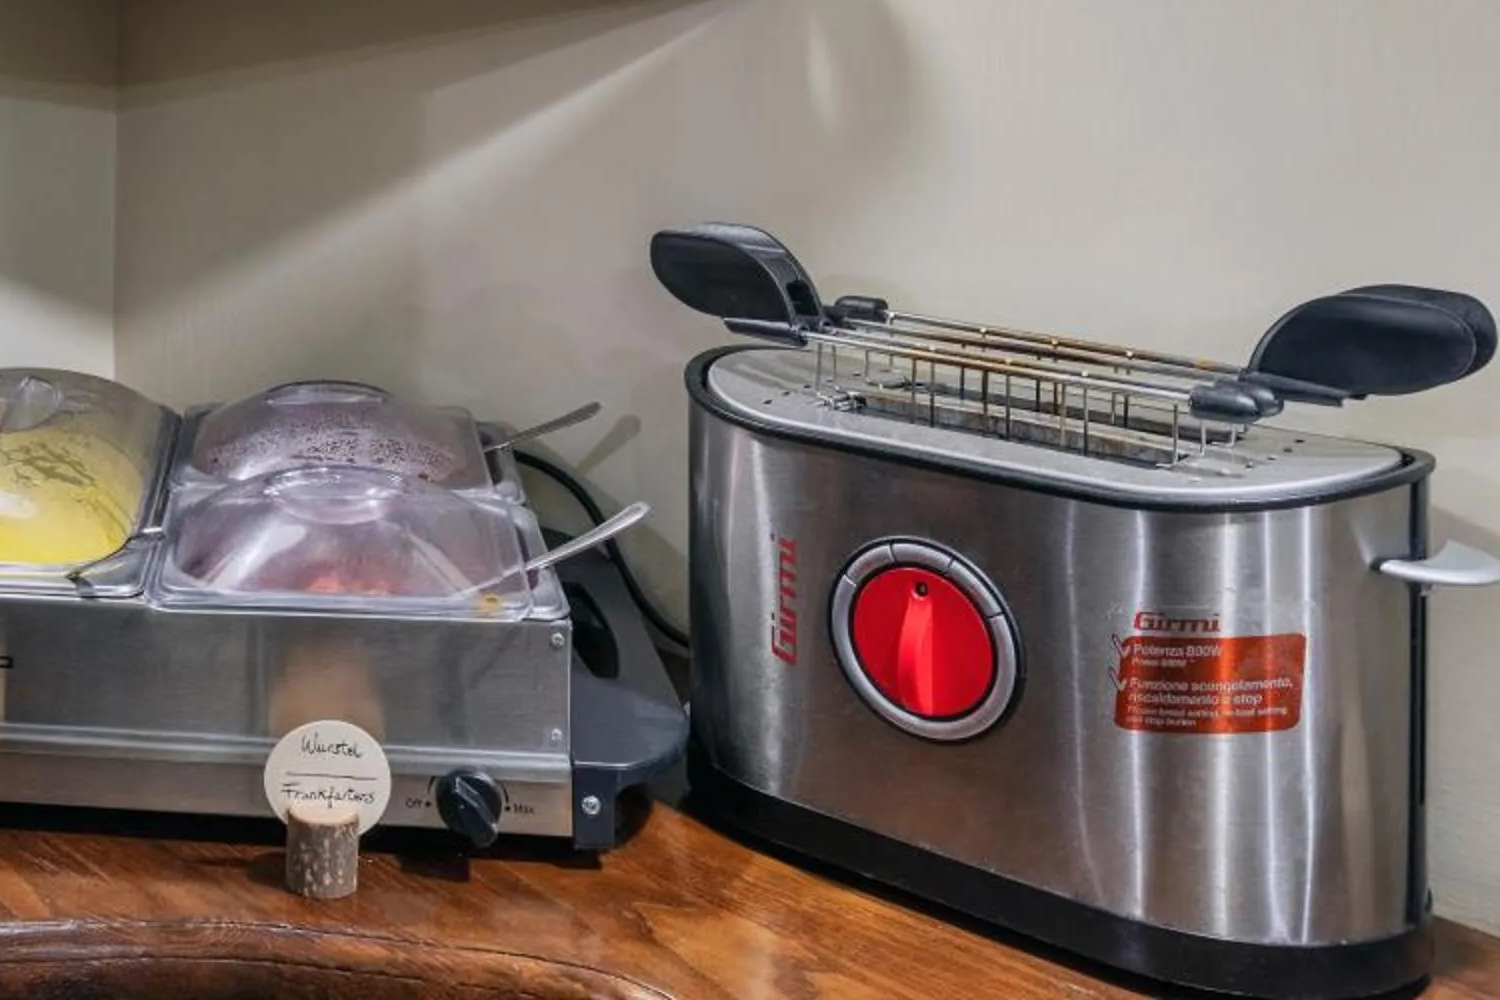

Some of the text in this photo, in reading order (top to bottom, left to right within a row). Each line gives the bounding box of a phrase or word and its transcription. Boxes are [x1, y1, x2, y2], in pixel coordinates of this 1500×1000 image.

[771, 533, 797, 666] Girmi
[1135, 612, 1221, 632] Girmi
[1132, 643, 1222, 657] Potenza 800W
[1130, 677, 1188, 691] Funzione
[1128, 693, 1219, 705] riscaldamento
[1233, 693, 1263, 706] stop
[404, 797, 423, 809] Off
